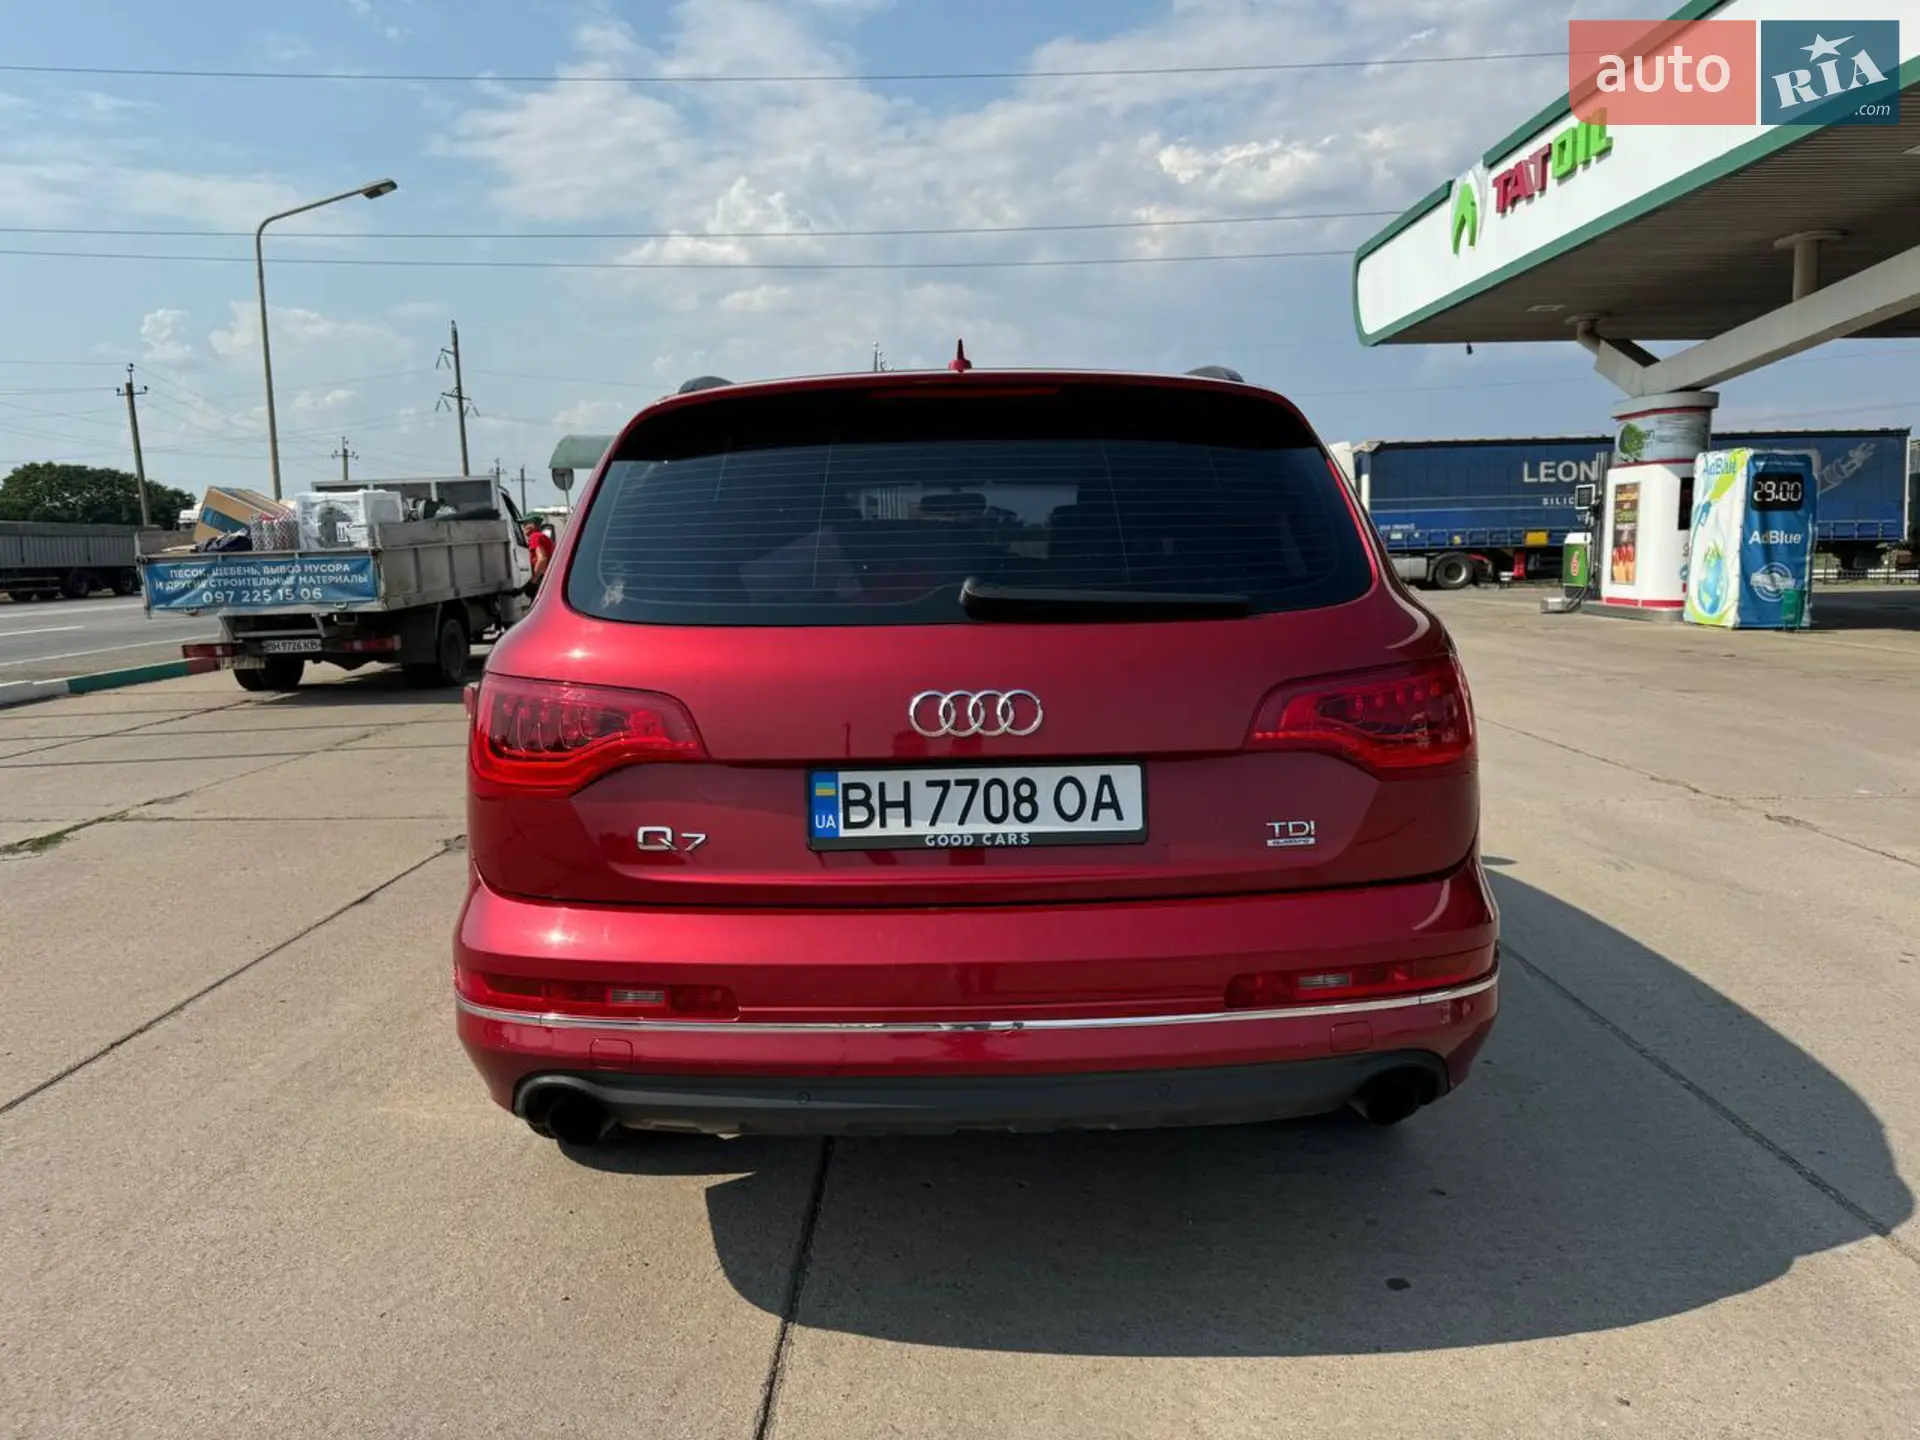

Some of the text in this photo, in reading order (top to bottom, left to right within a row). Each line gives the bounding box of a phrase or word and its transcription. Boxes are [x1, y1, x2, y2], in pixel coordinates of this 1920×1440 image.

[1754, 481, 1802, 502] 29.00
[1749, 530, 1803, 545] AdBlue
[262, 564, 302, 575] ВЫВОЗ
[304, 563, 350, 573] МУСОРА
[155, 580, 163, 590] И
[299, 574, 369, 585] МАТЕРИАЛЫ
[202, 587, 322, 604] 097 225 15 06
[815, 774, 1125, 829] UA BH 7708 OA
[1265, 820, 1316, 837] TDI
[636, 825, 707, 852] Q7
[924, 832, 1031, 847] GOOD CARS
